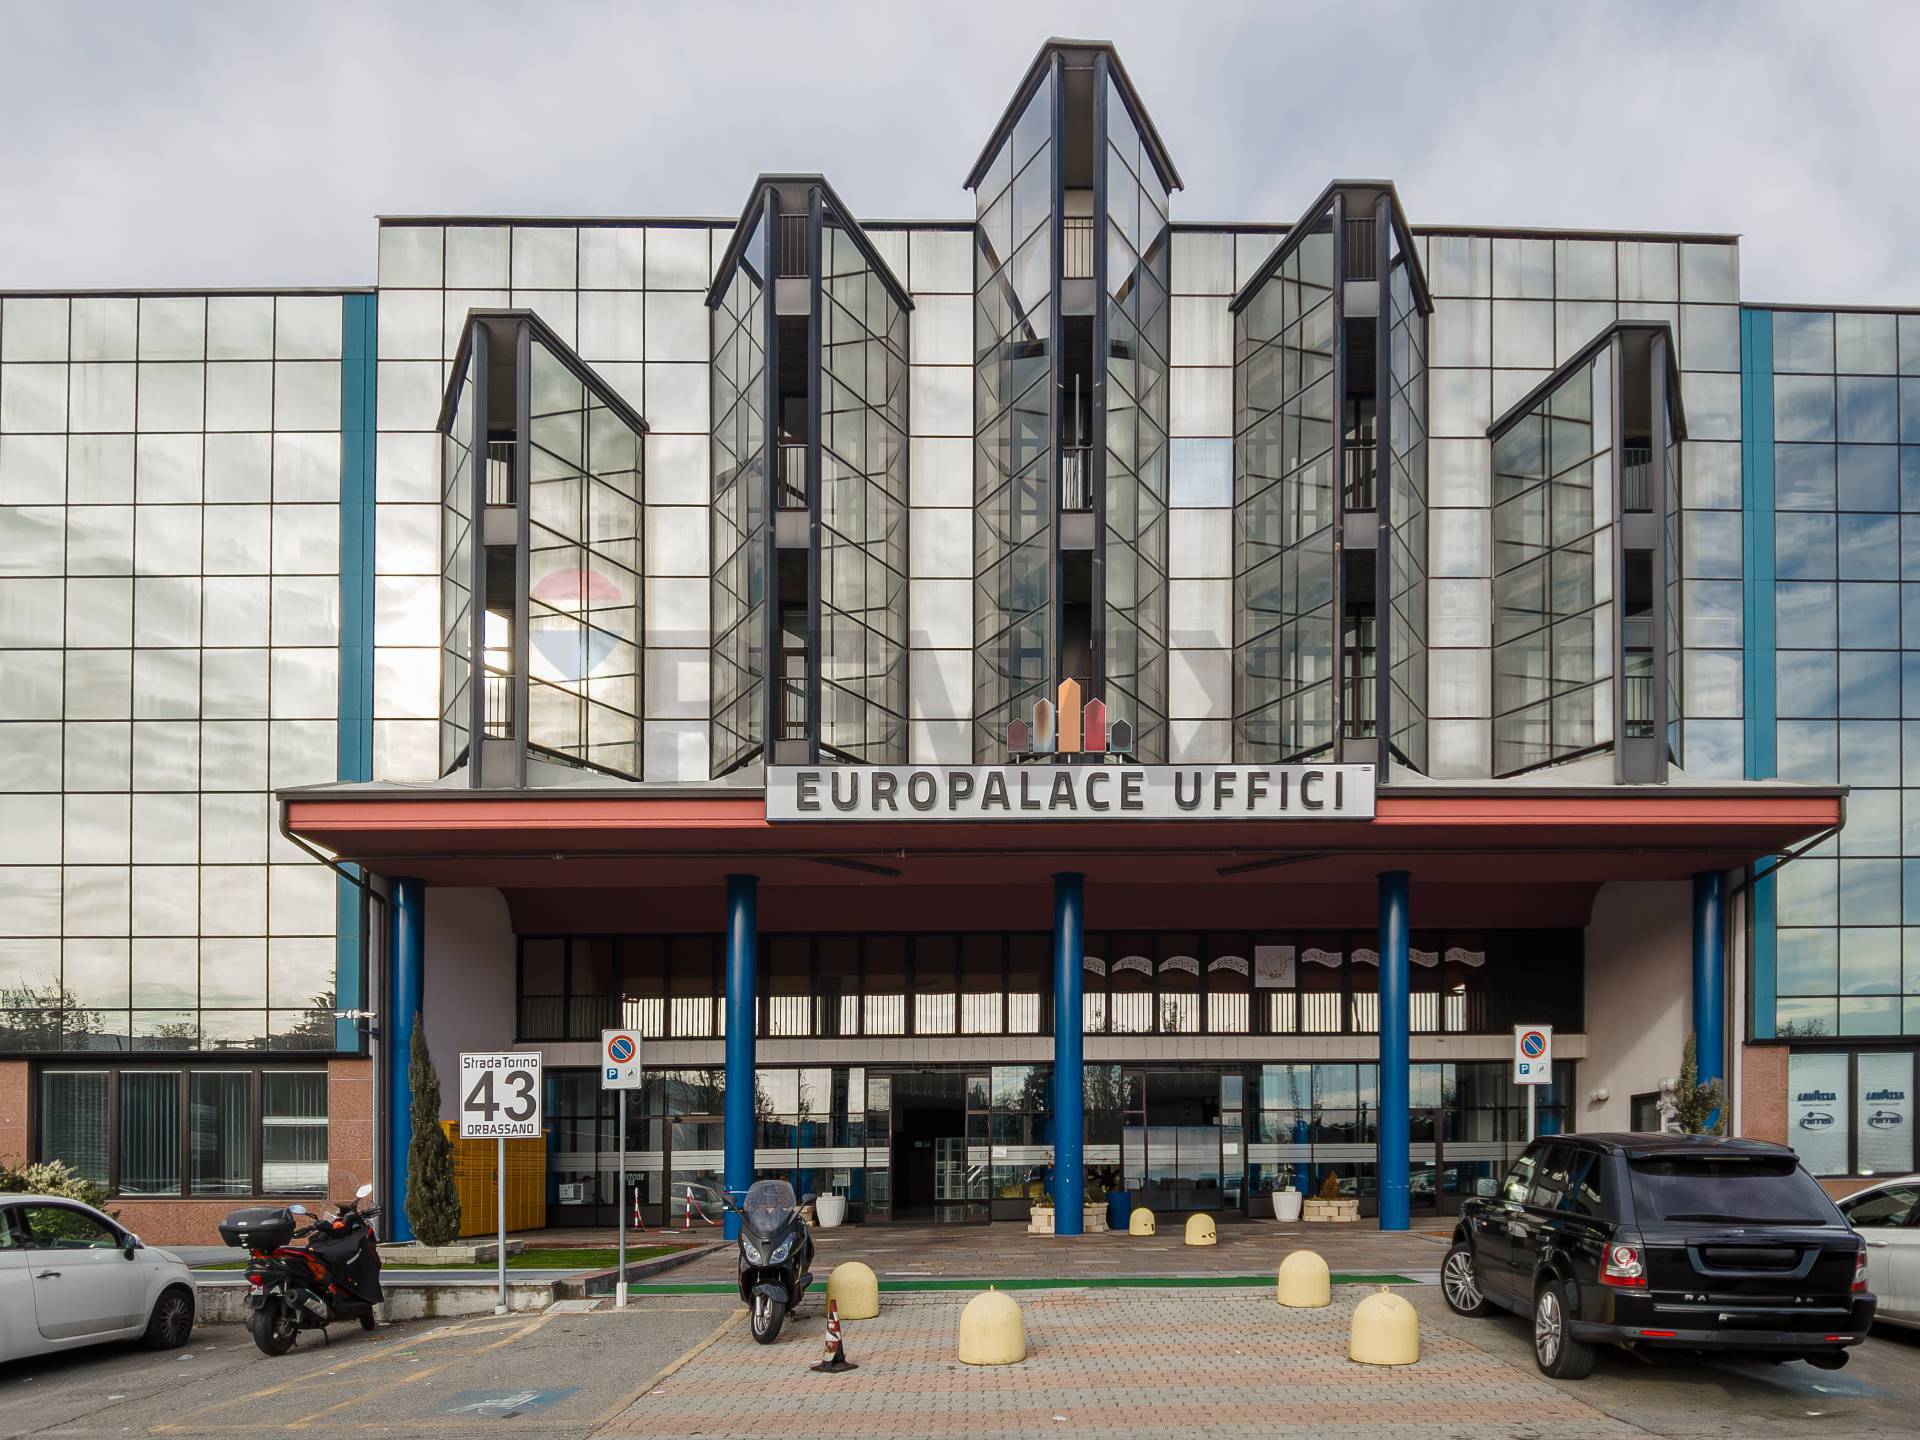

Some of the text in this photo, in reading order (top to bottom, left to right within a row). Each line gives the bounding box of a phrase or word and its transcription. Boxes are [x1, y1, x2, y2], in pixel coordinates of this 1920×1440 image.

[797, 771, 1344, 812] EUROPALACE UFFICI
[463, 1056, 538, 1069] Strada Torino
[463, 1070, 537, 1122] 43
[1797, 1089, 1837, 1101] LAVAZZA
[1866, 1089, 1905, 1100] LAVAZZA
[467, 1123, 534, 1135] ORBASSANO
